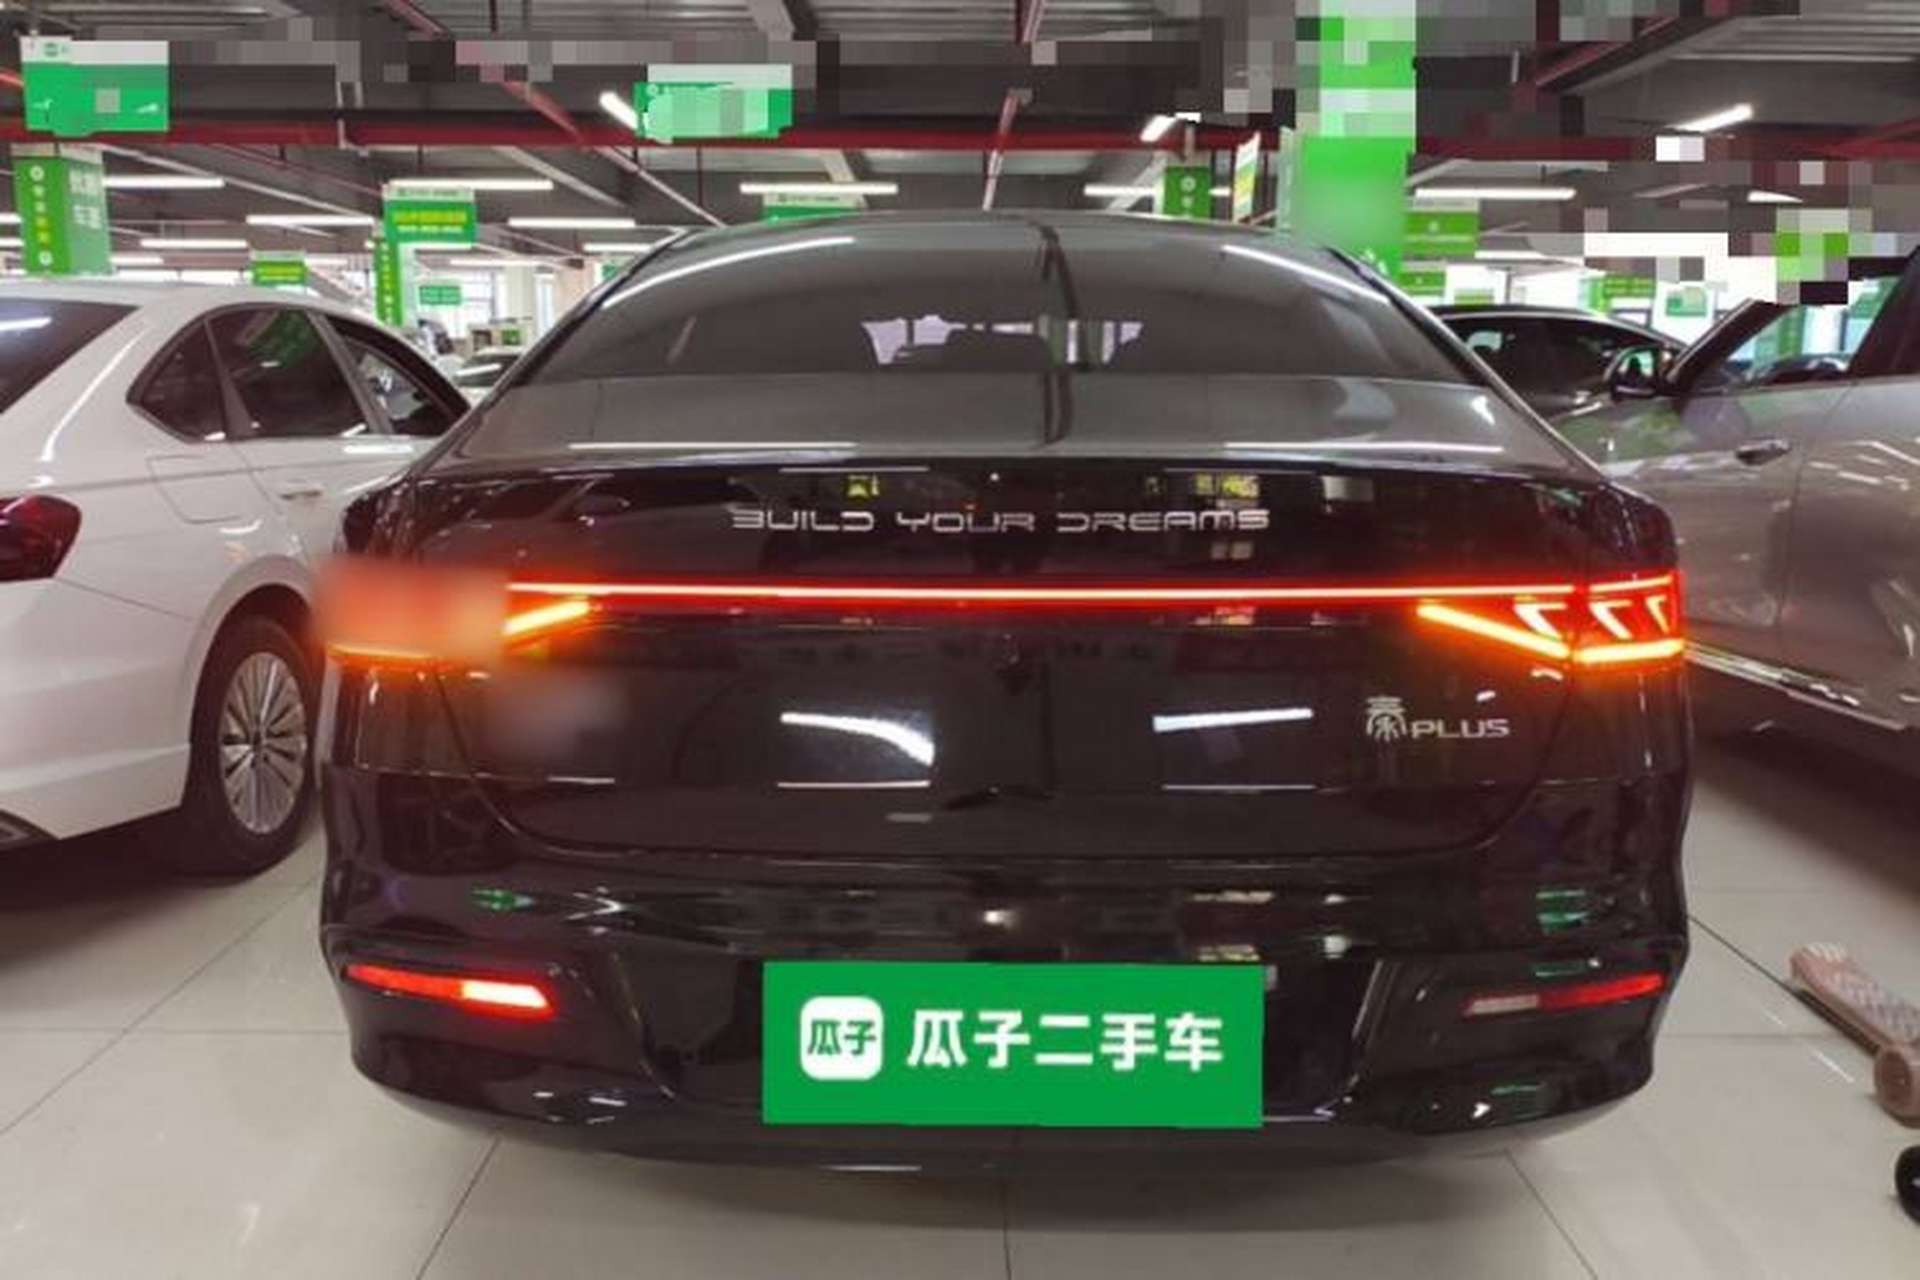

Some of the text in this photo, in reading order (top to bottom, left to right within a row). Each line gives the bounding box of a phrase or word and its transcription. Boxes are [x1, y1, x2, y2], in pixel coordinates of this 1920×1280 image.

[732, 508, 1270, 533] BUILD YOUR DREAMS
